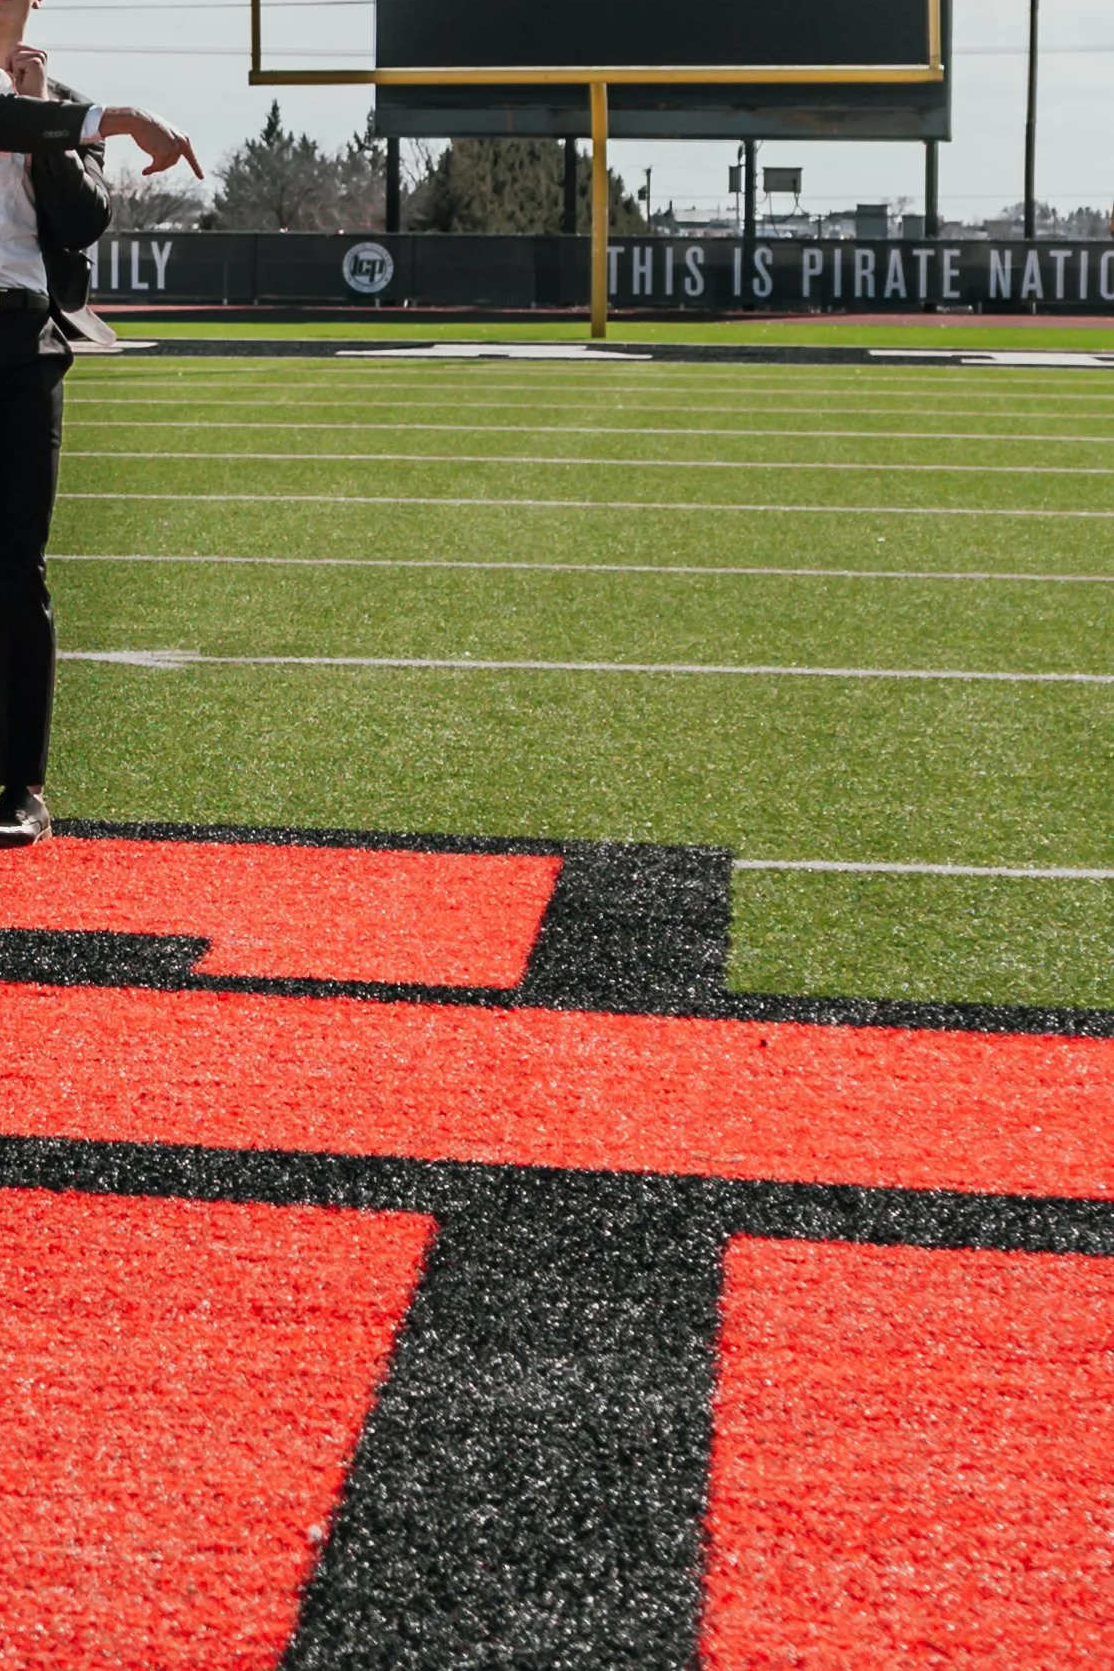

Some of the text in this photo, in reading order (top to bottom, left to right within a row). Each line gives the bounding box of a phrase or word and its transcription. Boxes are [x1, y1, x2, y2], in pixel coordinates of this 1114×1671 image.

[606, 246, 705, 297] THIS
[733, 247, 774, 297] IS
[802, 248, 961, 299] PIRATE
